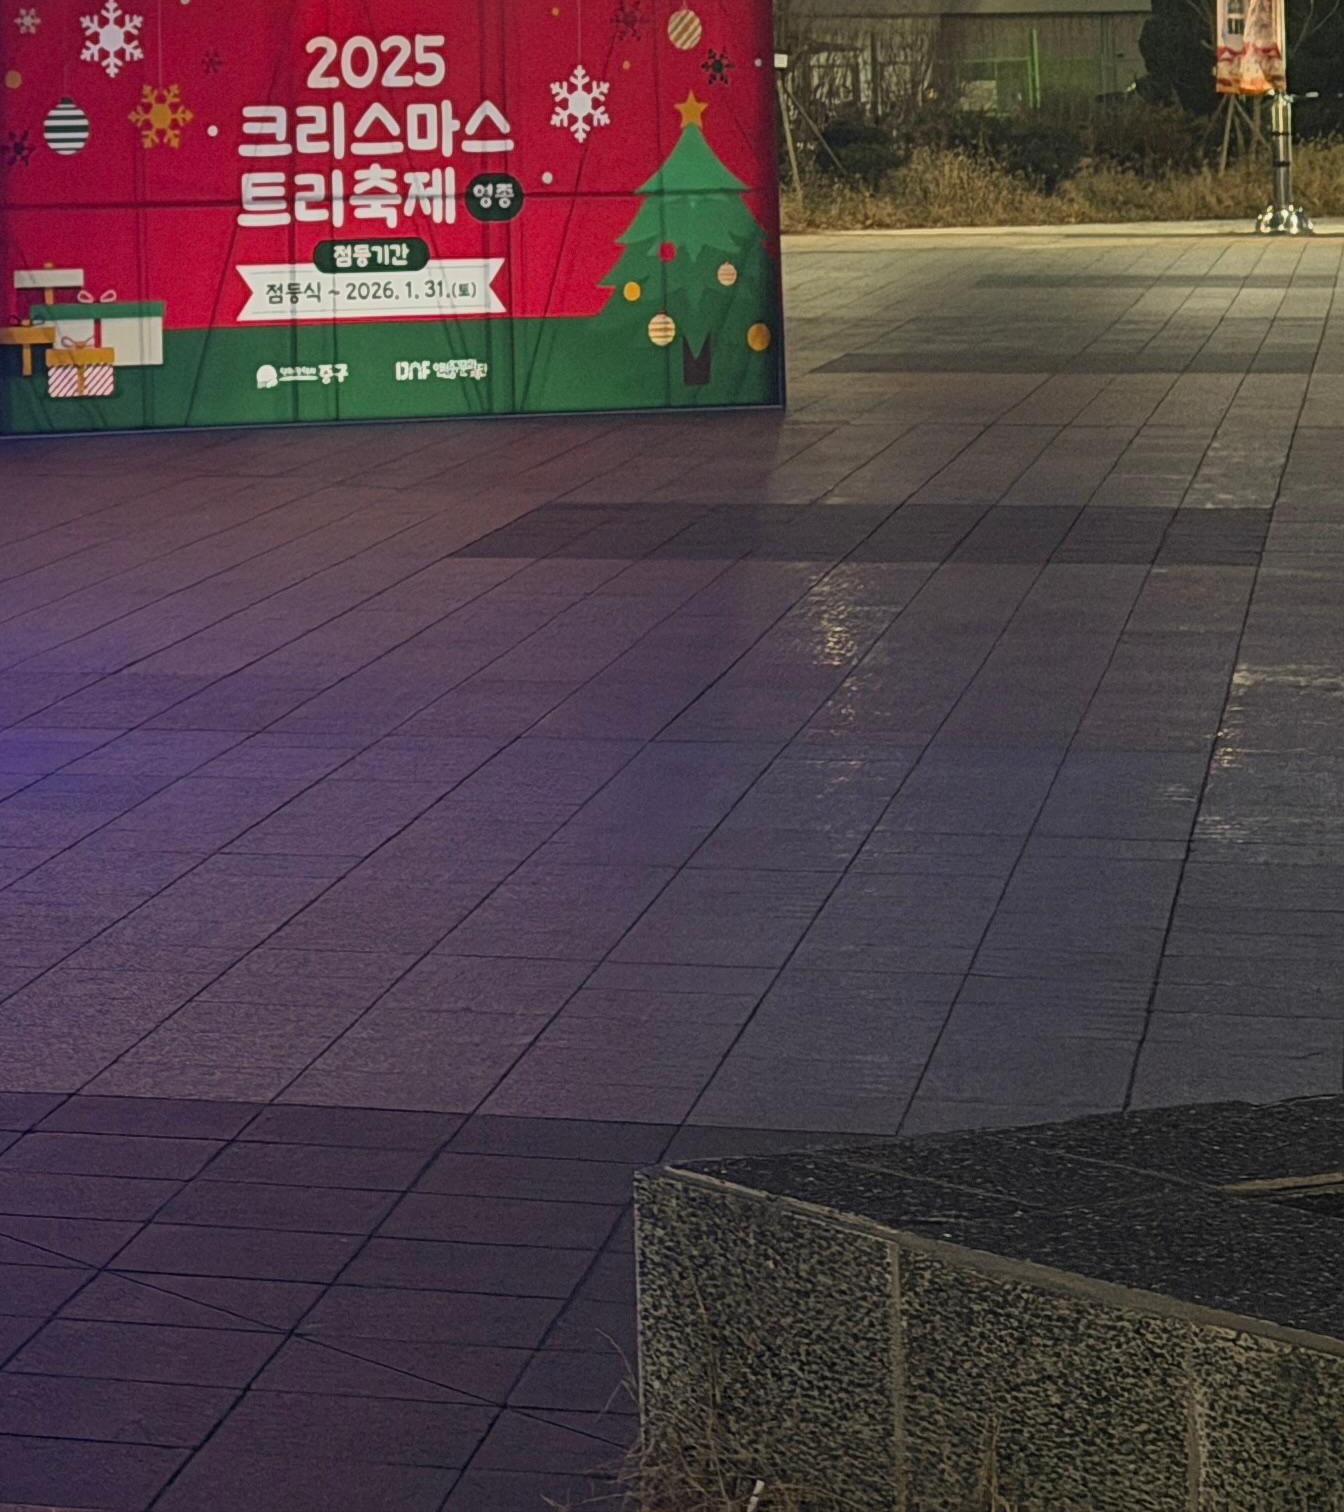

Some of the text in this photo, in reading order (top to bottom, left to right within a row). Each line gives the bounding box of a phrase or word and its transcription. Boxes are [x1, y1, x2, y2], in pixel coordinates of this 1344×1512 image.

[305, 33, 446, 89] 2025
[237, 99, 515, 159] 크리스마스
[237, 163, 515, 229] 트리축제 영종
[332, 242, 410, 268] 점등기간
[265, 281, 322, 305] 점등식
[345, 281, 400, 300] 2026.
